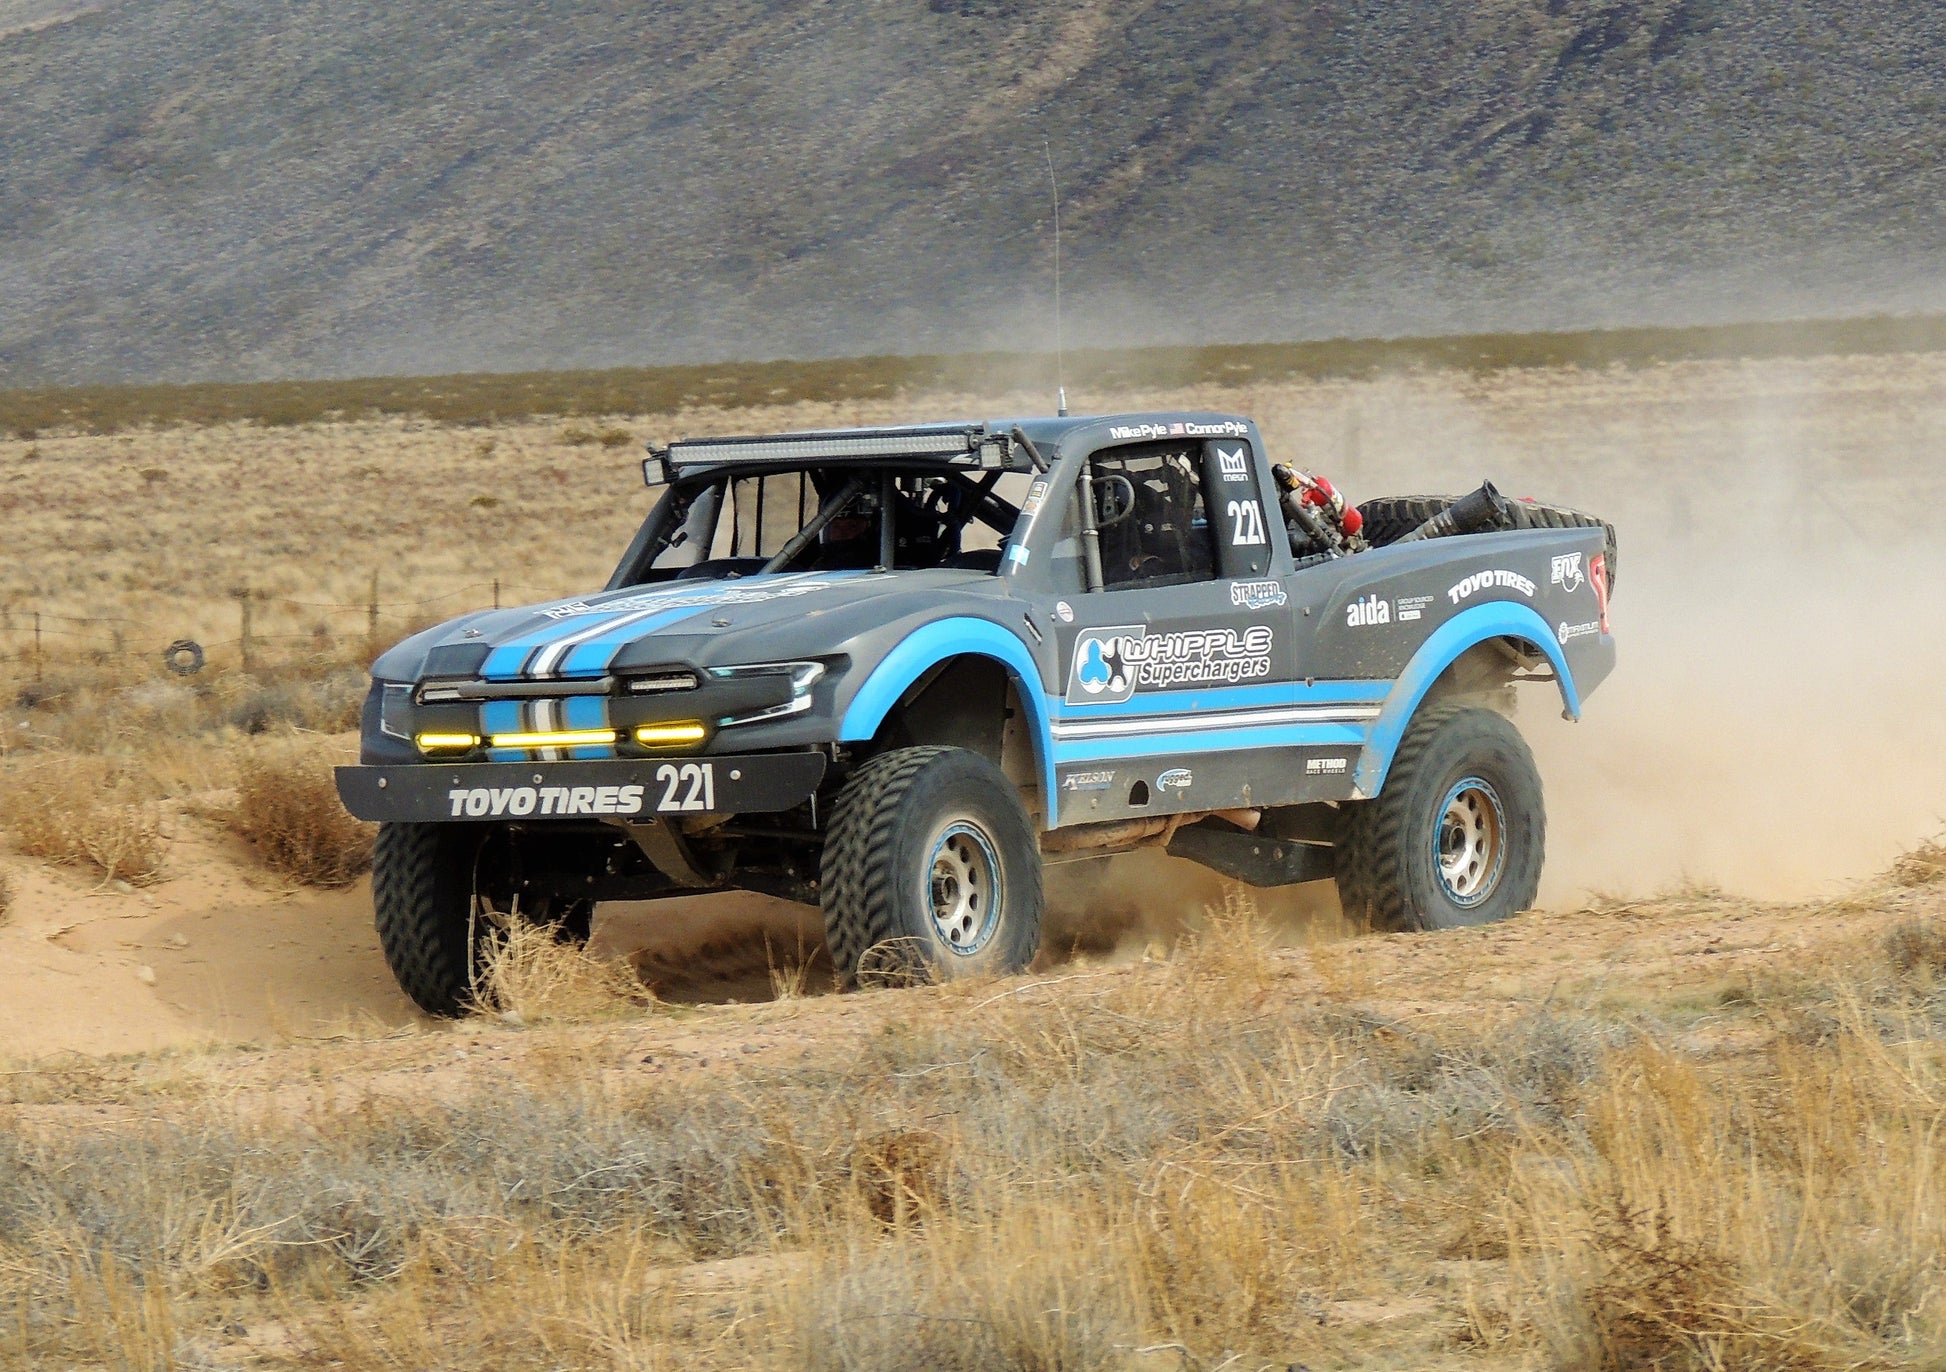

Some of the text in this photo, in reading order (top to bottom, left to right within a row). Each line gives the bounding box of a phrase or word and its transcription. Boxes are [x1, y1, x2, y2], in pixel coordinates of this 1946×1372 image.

[1109, 421, 1248, 439] Mike Pyle Connor Pyle
[1227, 500, 1266, 546] 221
[1447, 569, 1536, 604] TOYO TIRES
[1346, 594, 1390, 627] aida
[1125, 626, 1272, 664] WHIPPLE
[1139, 658, 1269, 685] Superchargers
[1306, 758, 1347, 769] METHOD
[448, 785, 645, 817] TOYO TIRES
[656, 763, 715, 812] 221
